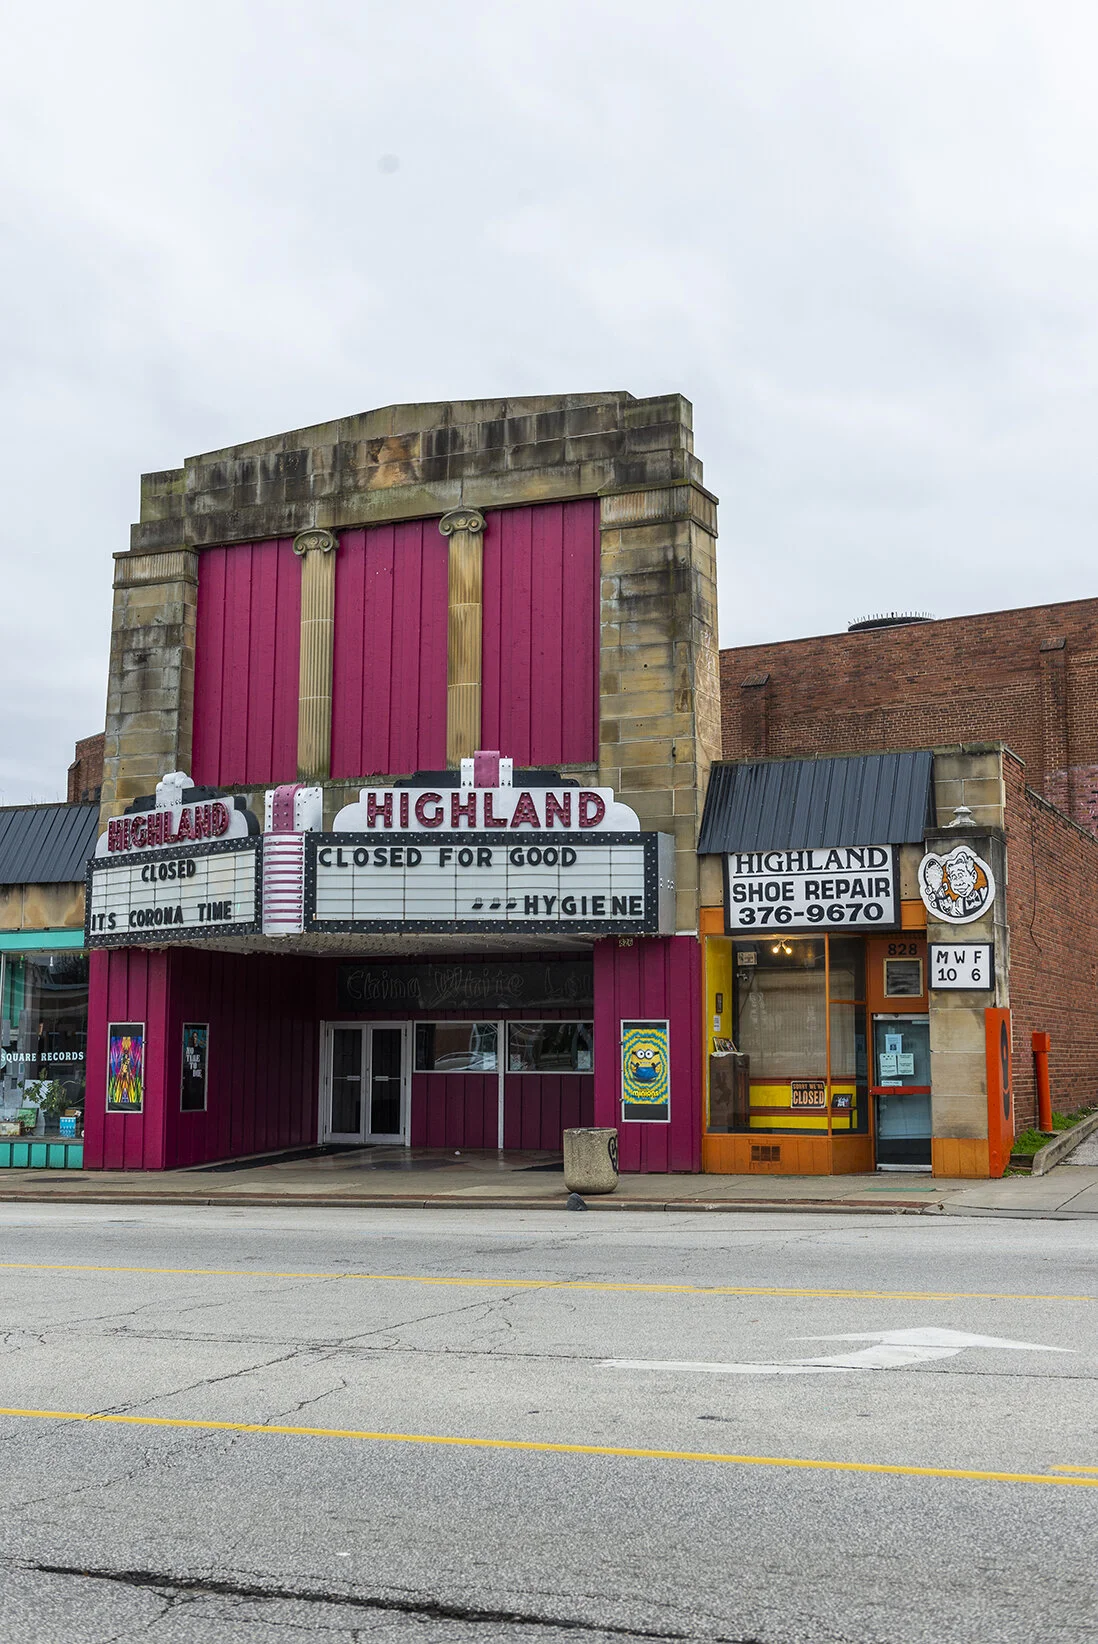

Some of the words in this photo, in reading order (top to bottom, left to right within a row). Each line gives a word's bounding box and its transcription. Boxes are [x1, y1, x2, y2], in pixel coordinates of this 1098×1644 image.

[367, 792, 606, 828] HIGHLAND
[108, 802, 230, 851] HIGHLAND
[318, 847, 422, 868] CLOSED
[439, 847, 492, 868] FOR
[509, 847, 577, 868] GOOD
[735, 847, 888, 874] HIGHLAND
[141, 859, 196, 882] CLOSED
[732, 881, 794, 903] SHOE
[805, 877, 890, 901] REPAIR
[91, 913, 116, 931] ITS
[129, 906, 183, 928] CORONA
[197, 900, 232, 922] TIME
[738, 902, 884, 925] 376-9670
[888, 943, 917, 955] 828
[936, 951, 948, 964] M
[954, 951, 965, 963] W
[974, 951, 982, 964] F
[346, 970, 421, 1000] China
[434, 966, 524, 998] White
[937, 968, 957, 981] 10
[971, 968, 981, 981] 6
[1, 1053, 37, 1063] SQUARE
[41, 1051, 84, 1061] RECORDS
[793, 1090, 824, 1105] CLOSED
